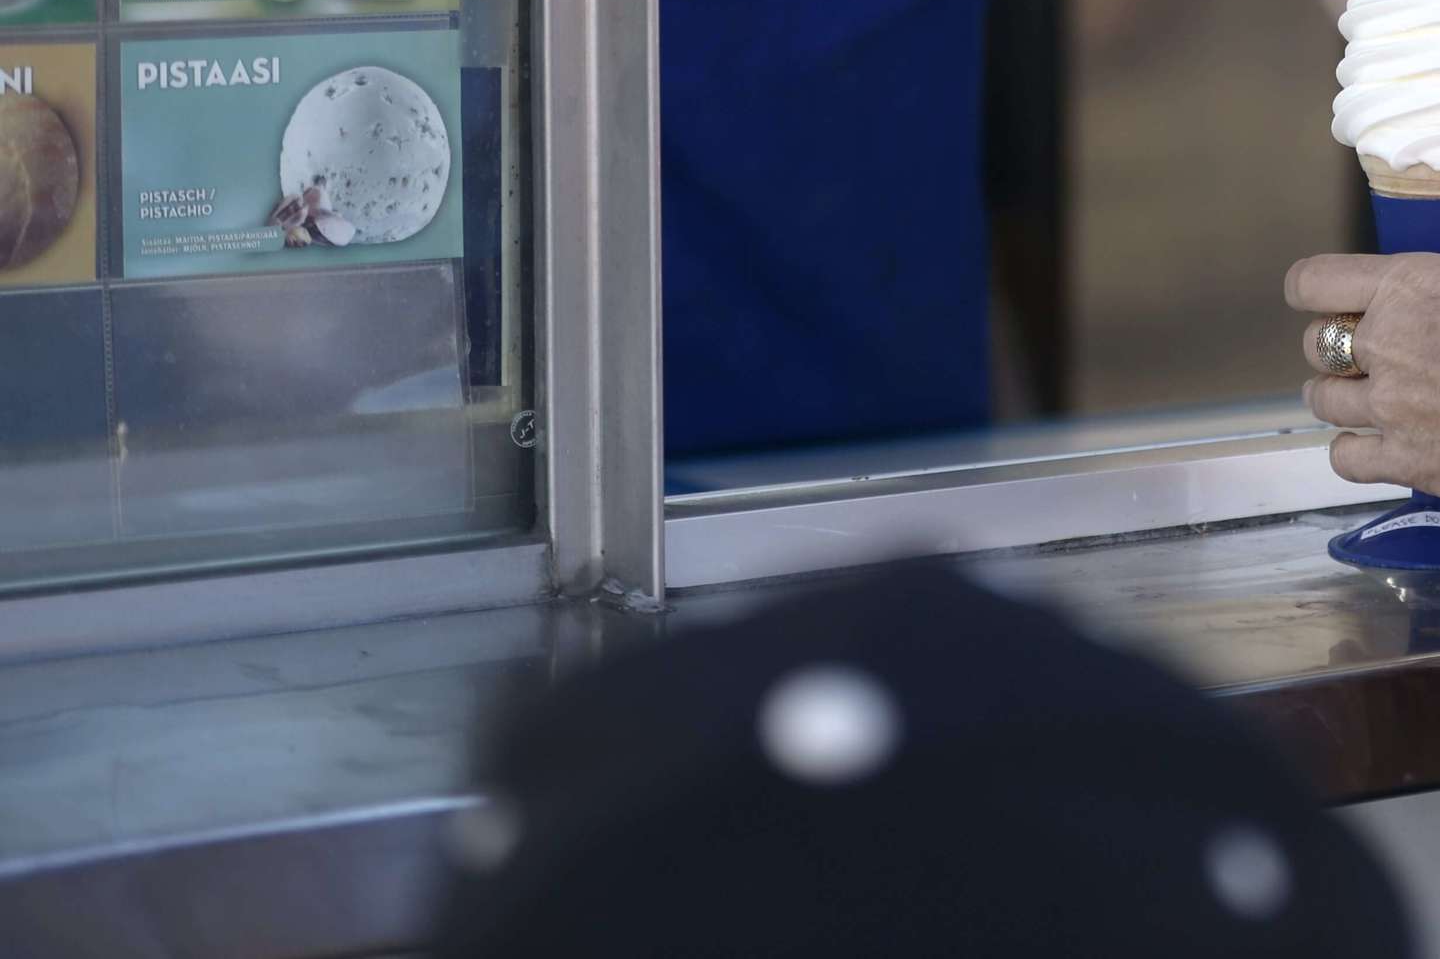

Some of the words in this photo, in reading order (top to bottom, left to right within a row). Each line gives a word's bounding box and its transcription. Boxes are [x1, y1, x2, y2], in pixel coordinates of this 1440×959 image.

[138, 57, 280, 90] PISTAASI
[140, 188, 206, 204] PISTASCH
[140, 204, 213, 219] PISTACHIO
[1366, 516, 1417, 535] PLEASE
